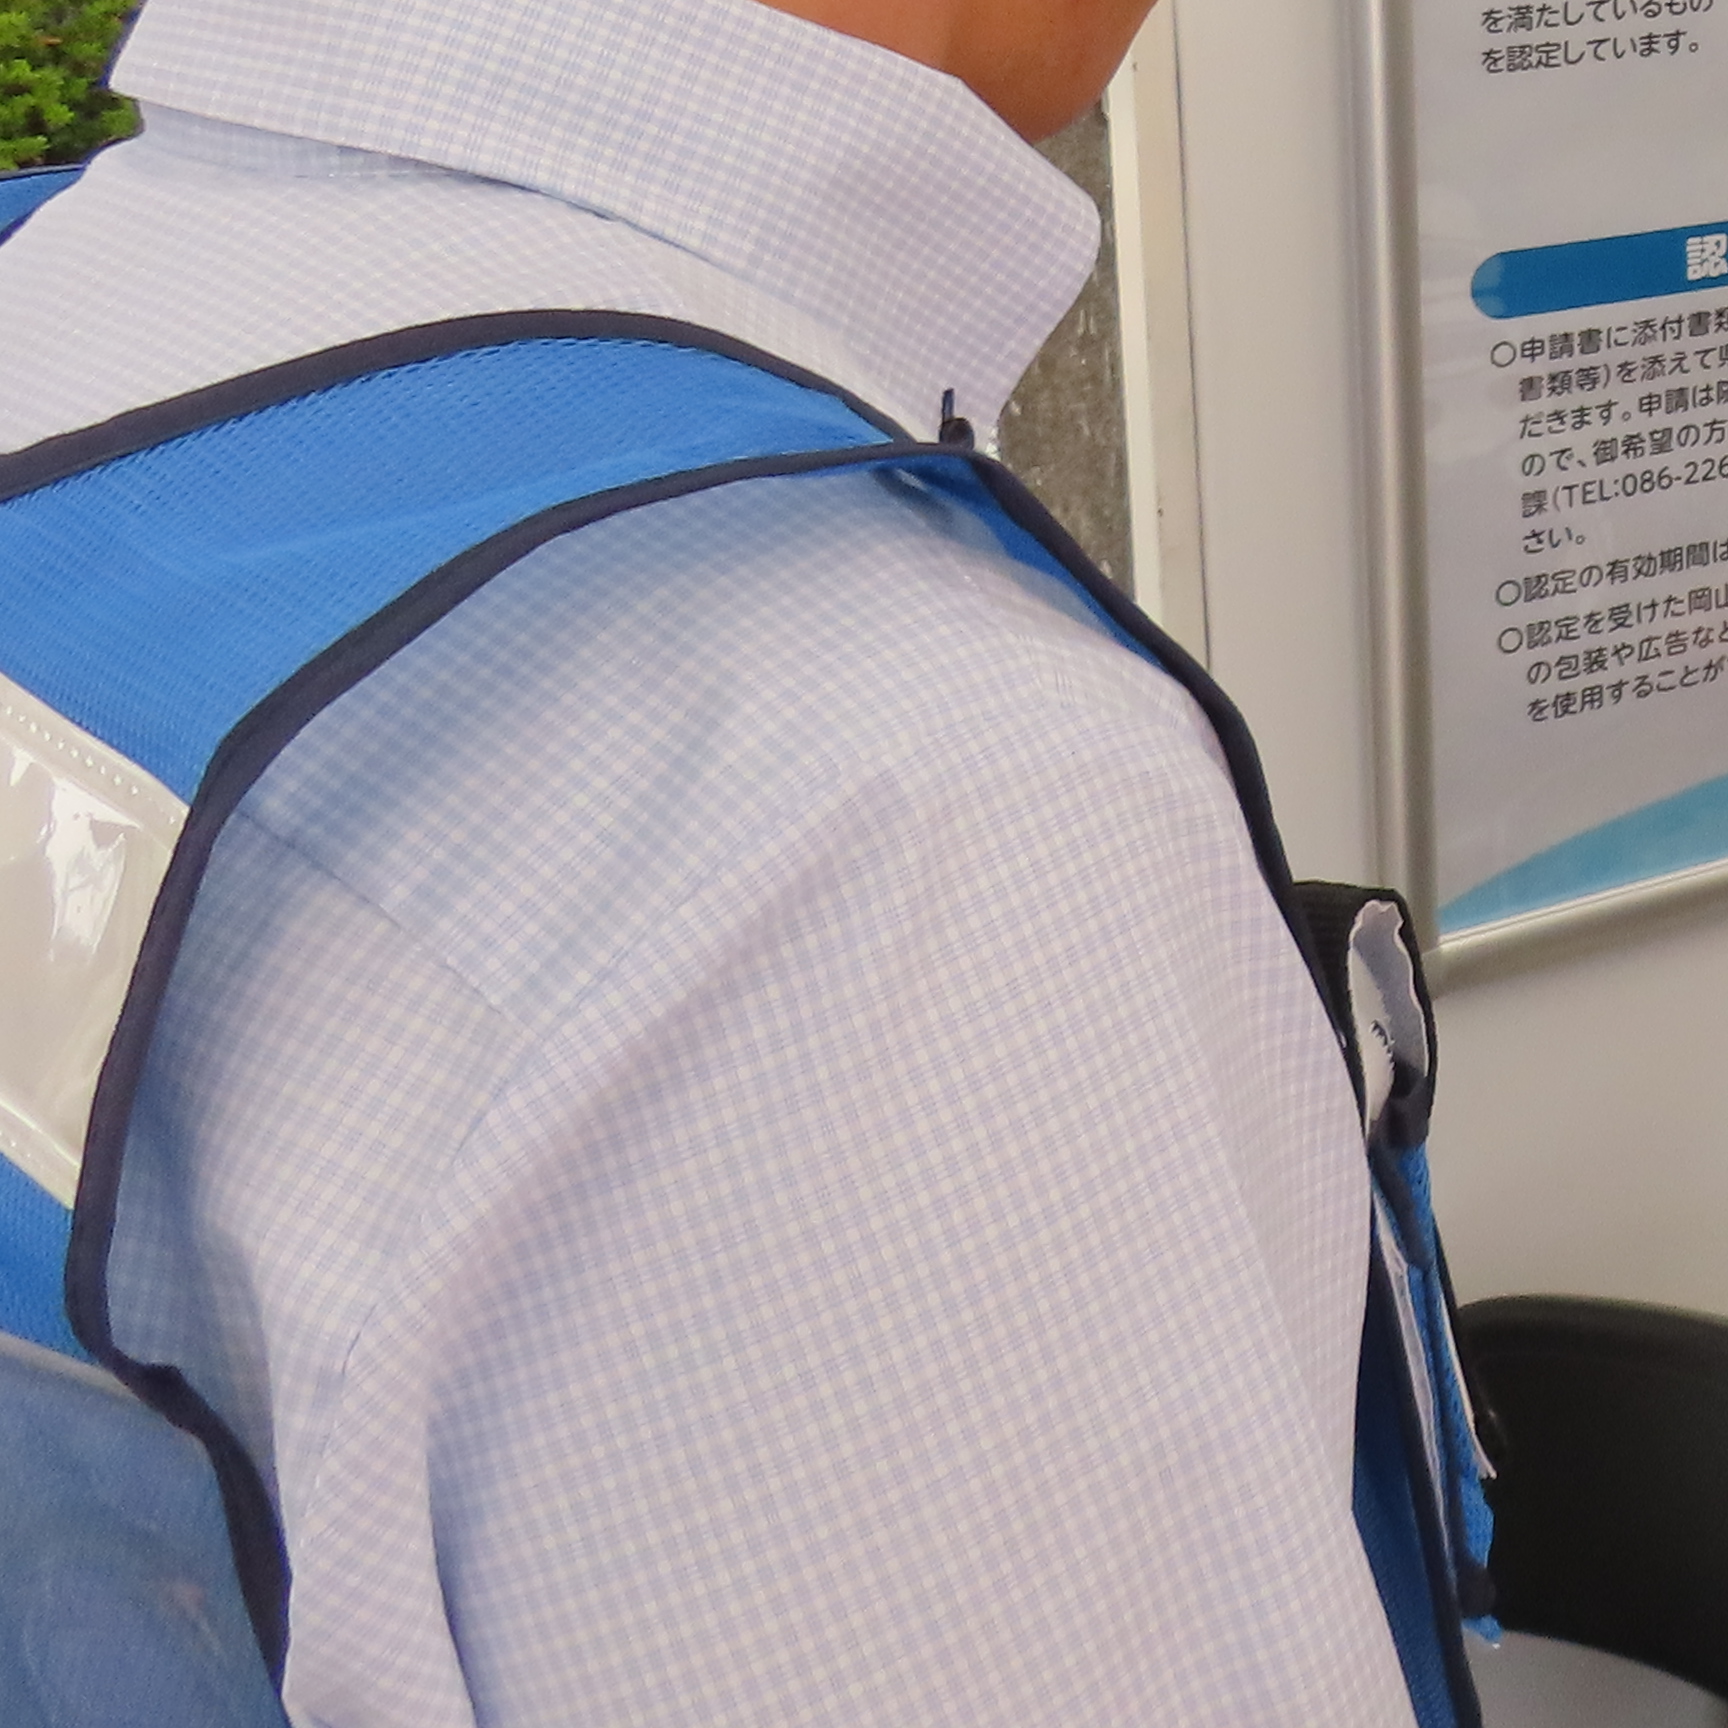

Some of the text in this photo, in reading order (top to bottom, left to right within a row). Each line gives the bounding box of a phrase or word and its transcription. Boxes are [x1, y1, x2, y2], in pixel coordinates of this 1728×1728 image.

[1480, 30, 1700, 75] を認定しています。
[1522, 525, 1587, 556] さい。
